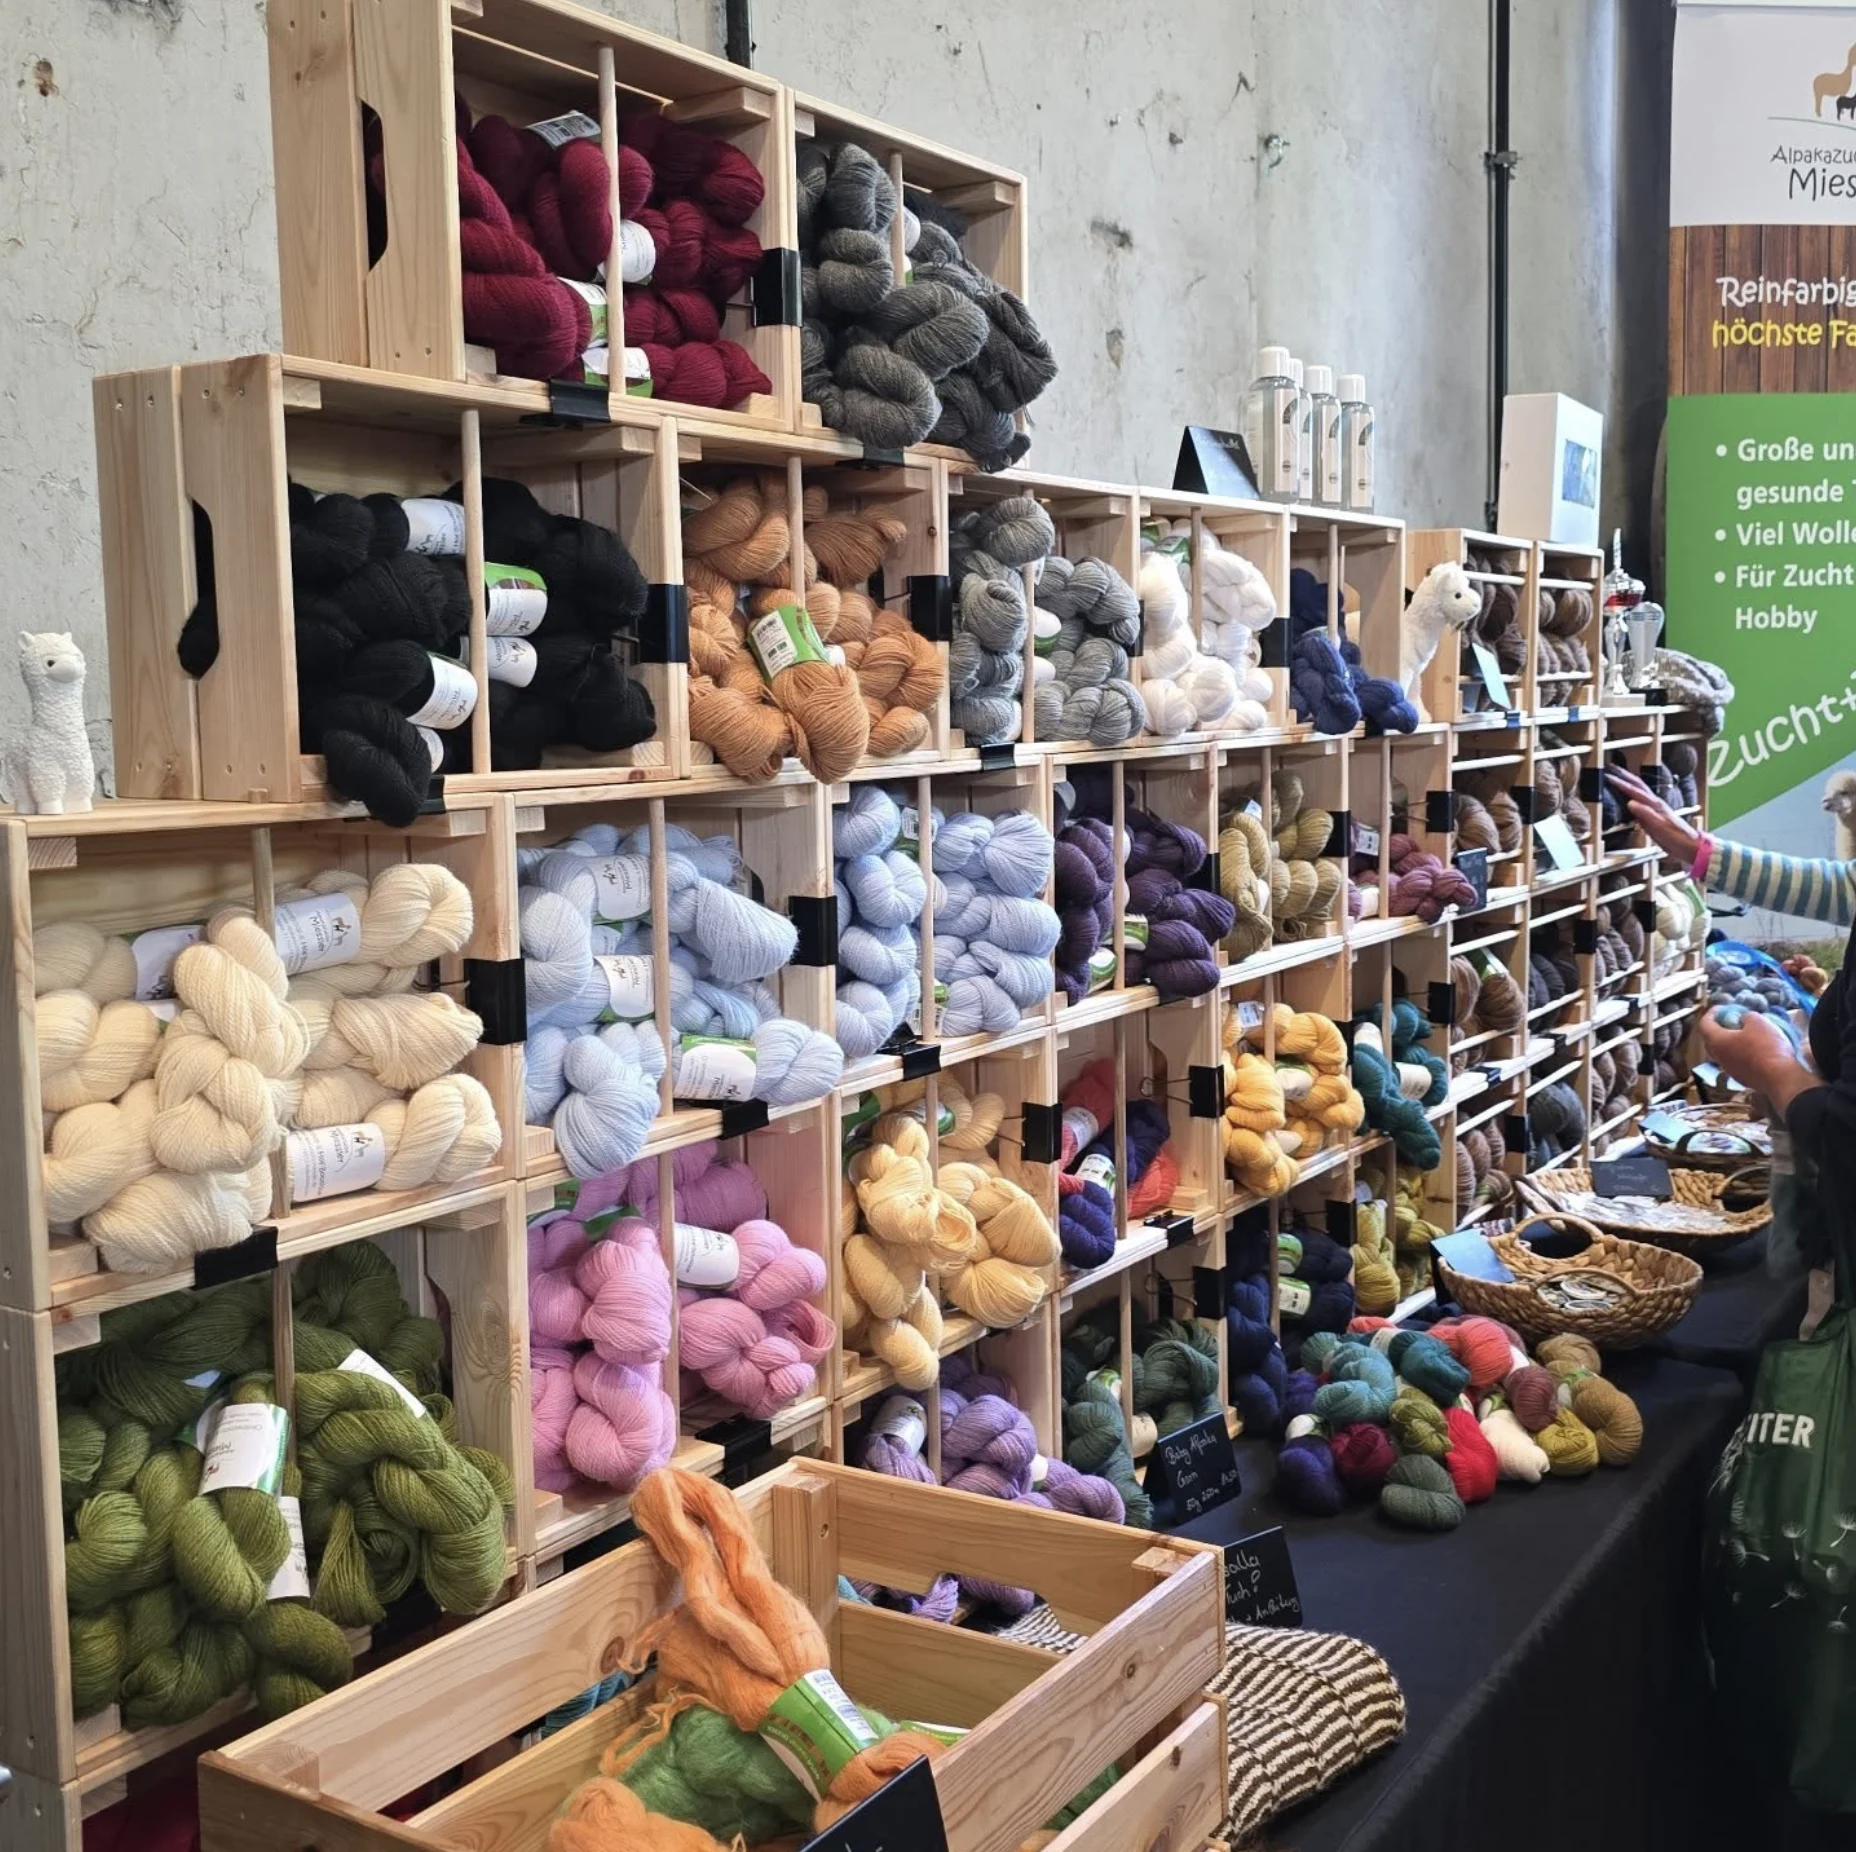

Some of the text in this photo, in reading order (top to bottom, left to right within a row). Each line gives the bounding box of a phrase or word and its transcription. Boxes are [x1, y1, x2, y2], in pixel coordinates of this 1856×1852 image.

[1769, 145, 1856, 164] Alpakazu
[1788, 167, 1856, 201] Mies
[1715, 276, 1856, 307] Reinfarbig
[1712, 317, 1823, 348] höchste
[1737, 436, 1815, 462] Große
[1736, 478, 1844, 511] gesunde
[1735, 520, 1784, 546] Viel
[1735, 561, 1854, 588] Für Zucht
[1735, 603, 1818, 634] Hobby
[1746, 1411, 1815, 1448] ITER
